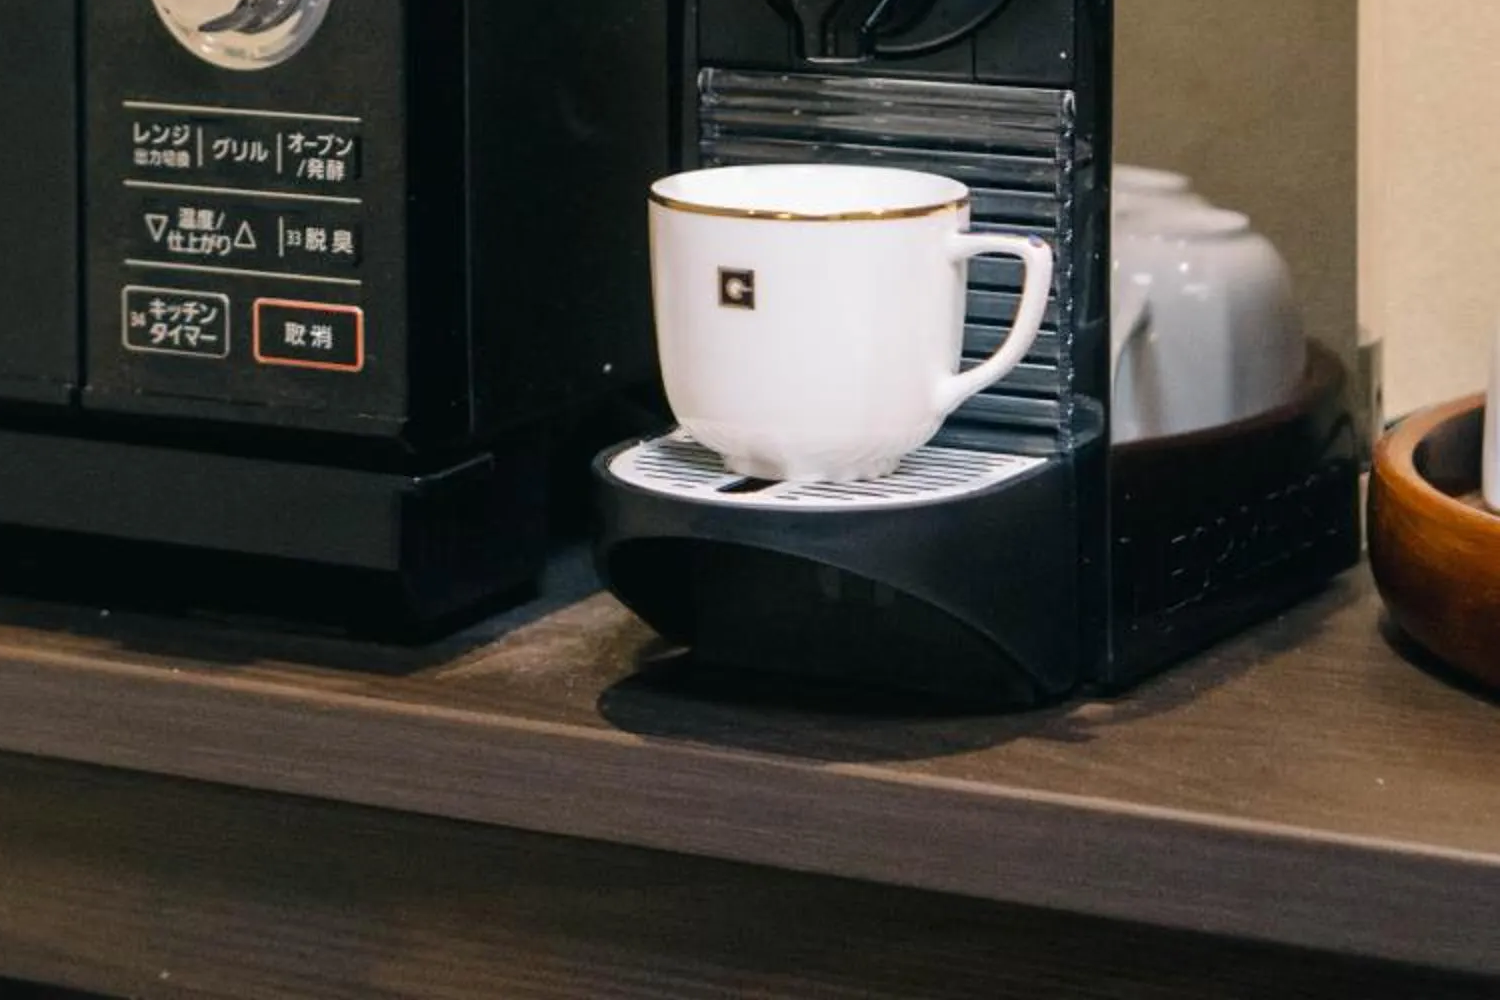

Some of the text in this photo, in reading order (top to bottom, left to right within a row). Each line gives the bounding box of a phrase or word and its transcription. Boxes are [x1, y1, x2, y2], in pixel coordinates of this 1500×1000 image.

[133, 121, 191, 146] レンジ
[288, 133, 353, 156] オープン
[212, 137, 269, 162] グリル
[167, 229, 232, 256] 仕上がり
[287, 230, 302, 246] 33
[149, 298, 218, 325] キッチン
[150, 322, 218, 346] タイマー
[284, 321, 333, 349] 取消
